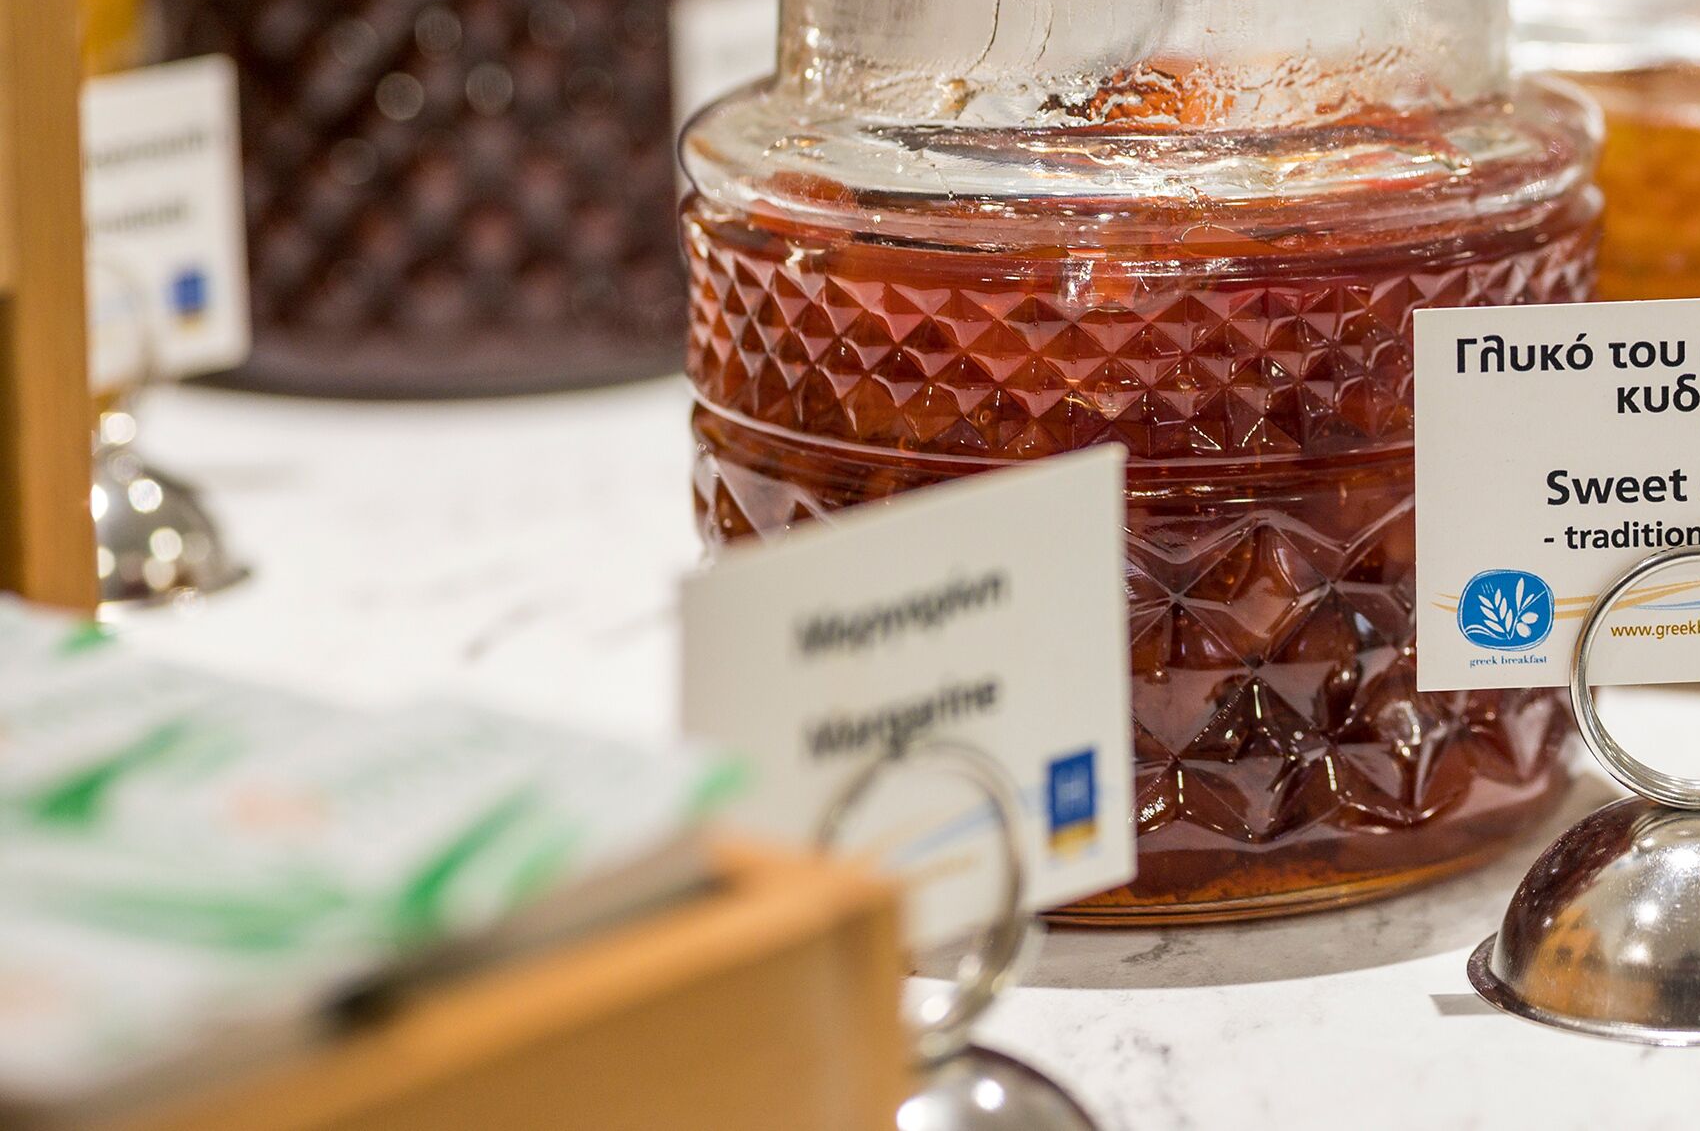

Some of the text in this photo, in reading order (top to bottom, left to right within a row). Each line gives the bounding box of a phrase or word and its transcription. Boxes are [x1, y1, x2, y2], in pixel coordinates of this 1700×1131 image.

[1456, 333, 1594, 373] Γλυκό
[1609, 340, 1686, 370] του
[1546, 468, 1688, 506] Sweet
[1470, 654, 1547, 668] greek breakfast
